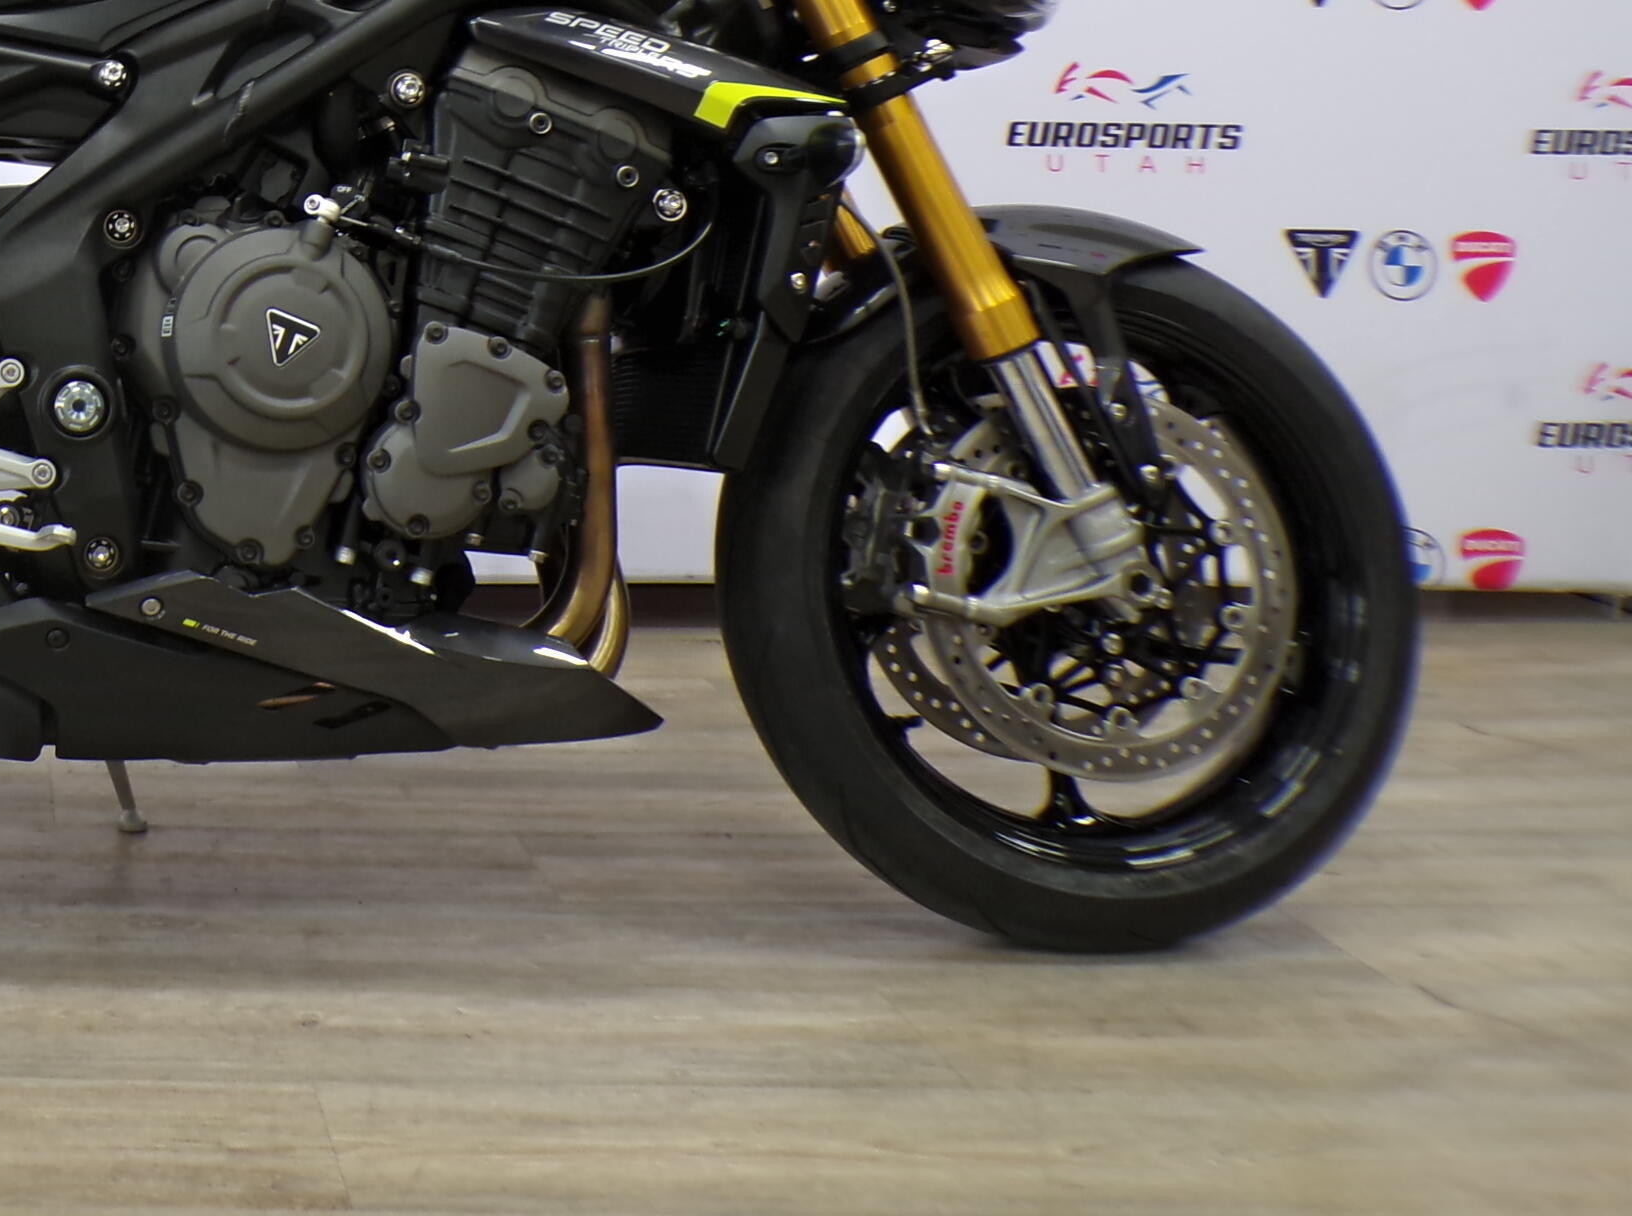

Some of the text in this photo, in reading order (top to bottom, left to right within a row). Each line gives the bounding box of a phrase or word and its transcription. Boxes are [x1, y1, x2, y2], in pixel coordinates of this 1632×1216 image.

[544, 11, 671, 53] SPEED
[1007, 122, 1242, 149] EUROSPORTS
[1049, 154, 1206, 173] UTAH
[935, 500, 965, 575] brembo
[202, 624, 220, 634] FOR
[220, 630, 238, 639] THE
